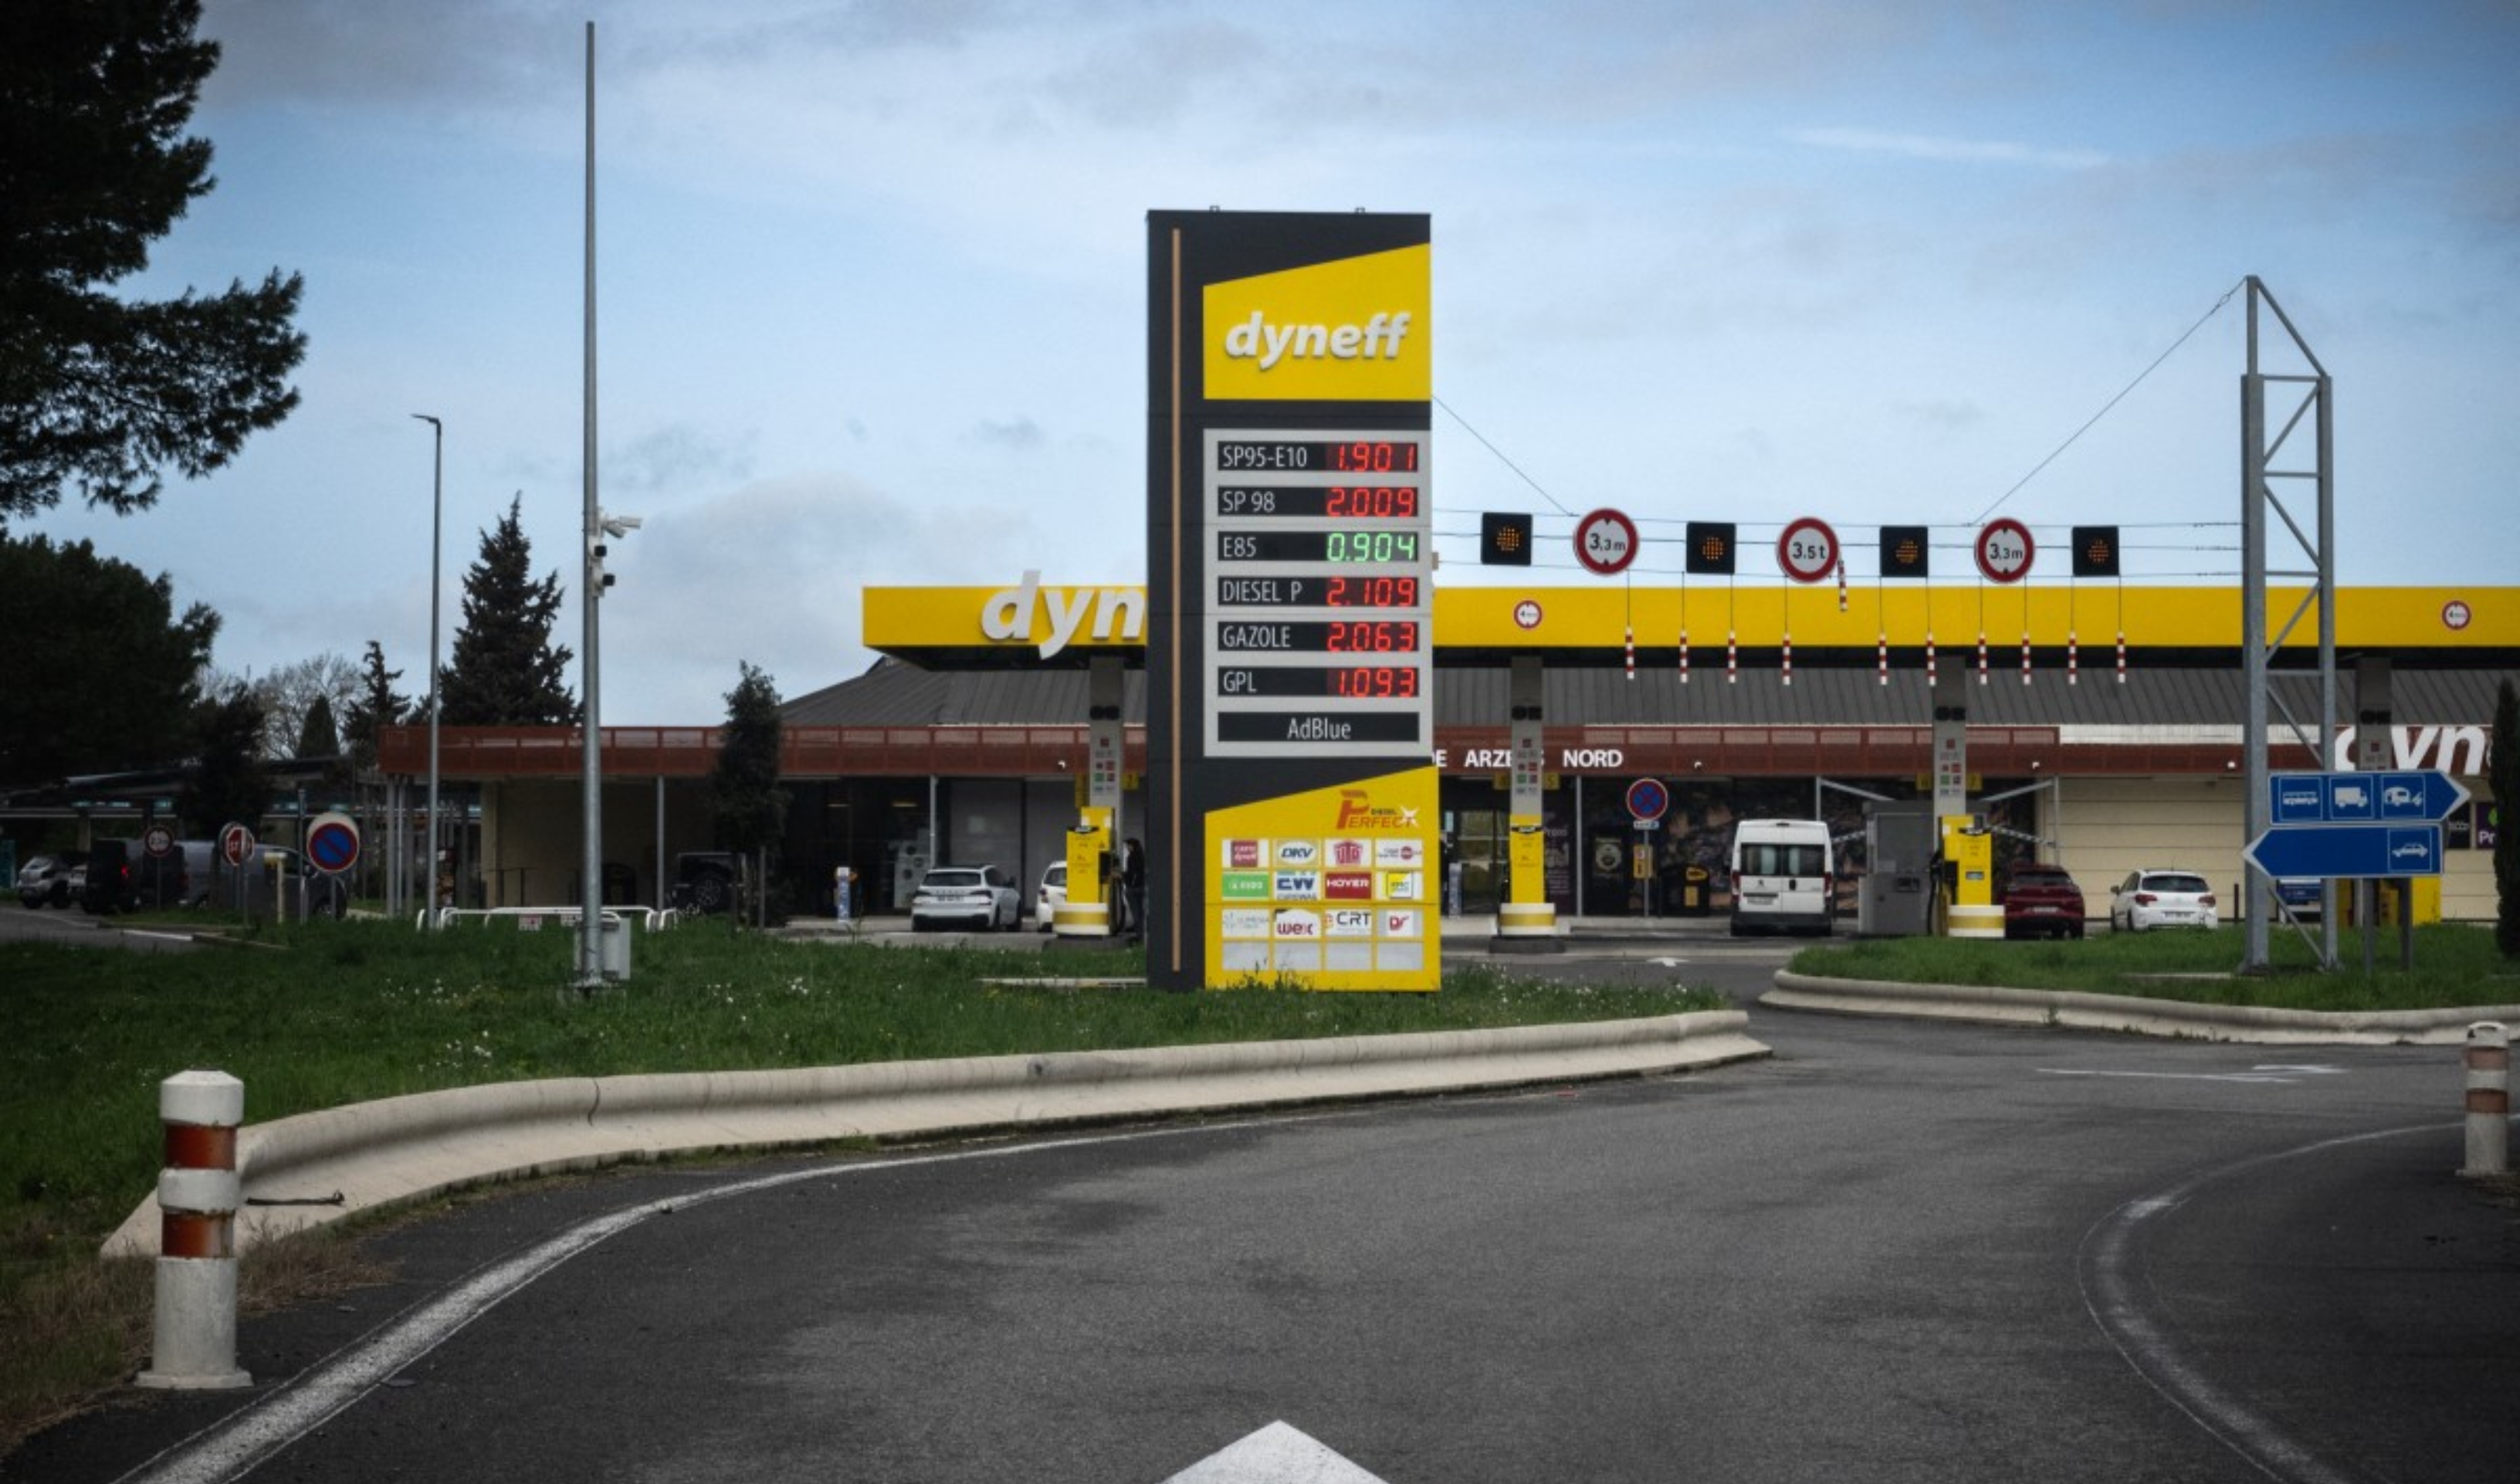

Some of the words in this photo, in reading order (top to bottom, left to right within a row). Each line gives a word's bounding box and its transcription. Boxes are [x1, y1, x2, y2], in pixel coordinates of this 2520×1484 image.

[1224, 310, 1411, 371] dyneff
[1223, 446, 1307, 467] SP95-E10
[1337, 442, 1414, 471] 1.901
[1223, 492, 1245, 512] SP
[1252, 492, 1275, 512] 98
[1327, 487, 1414, 517] 2.009
[1224, 537, 1256, 557] E85
[1327, 533, 1414, 562] 0.904
[1223, 581, 1282, 601] DIESEL
[1291, 581, 1302, 601] P
[1327, 578, 1414, 607] 2.109
[1223, 626, 1290, 647] GAZOLE
[1327, 622, 1414, 652] 2.063
[1224, 672, 1256, 693] GPL
[1338, 669, 1414, 697] 1.093
[1287, 718, 1351, 740] AdBlue
[1563, 749, 1624, 767] NORD
[1281, 848, 1313, 858] DKV
[1326, 878, 1370, 888] HOYER
[1336, 911, 1372, 926] CRT
